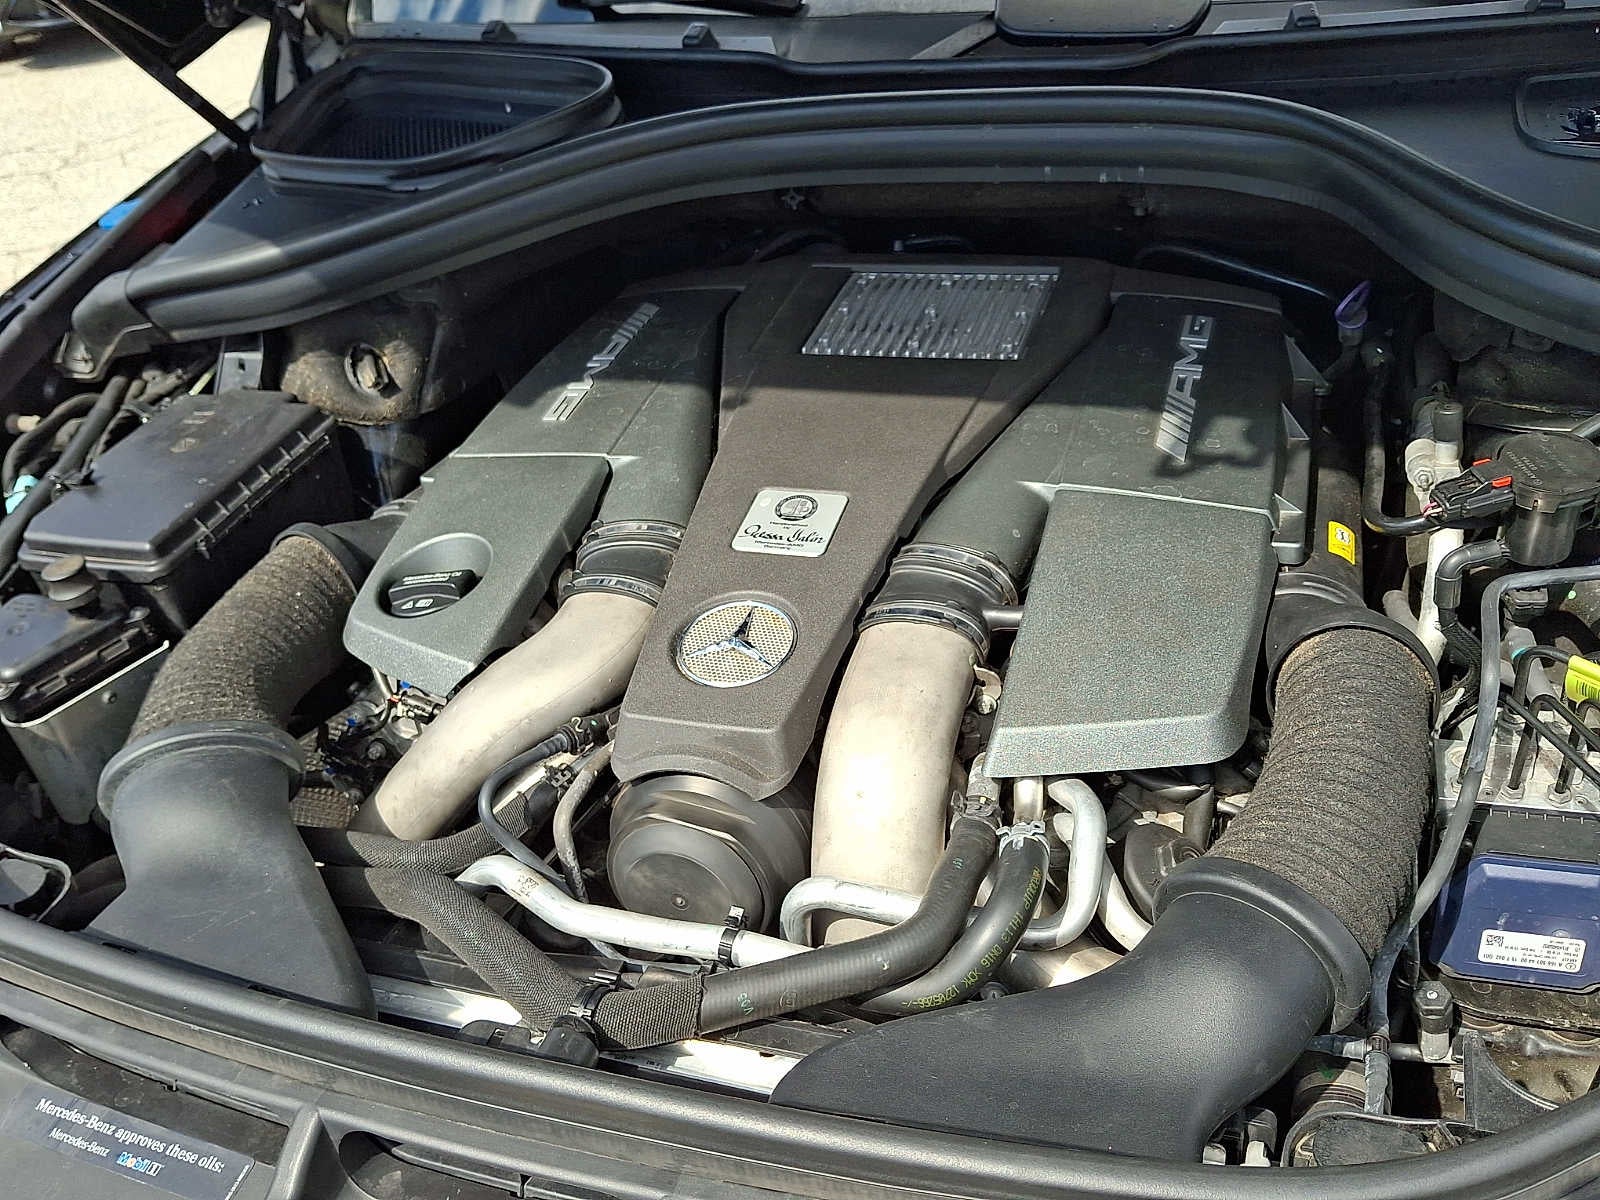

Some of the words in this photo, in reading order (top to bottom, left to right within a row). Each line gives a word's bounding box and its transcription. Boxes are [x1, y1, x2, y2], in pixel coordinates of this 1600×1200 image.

[35, 1098, 116, 1136] Mercedes-Benz
[115, 1127, 166, 1153] approves
[165, 1143, 198, 1166] these
[198, 1156, 225, 1174] oils:
[50, 1128, 110, 1158] Mercedes-Benz
[116, 1151, 151, 1172] Mobil
